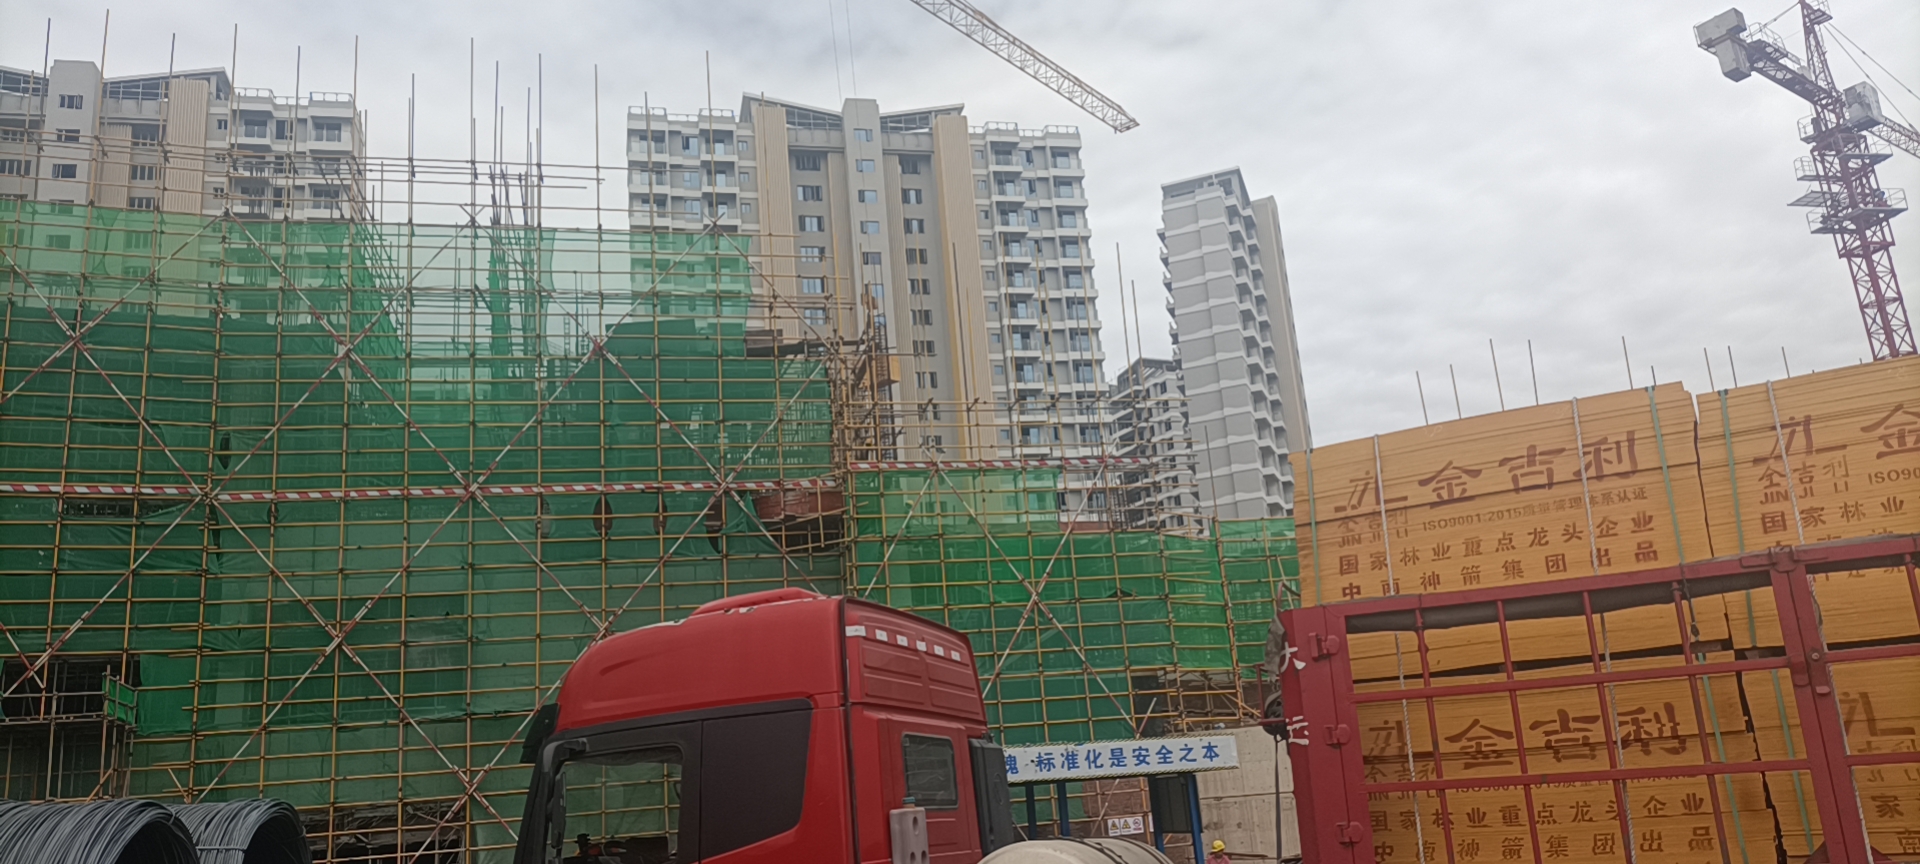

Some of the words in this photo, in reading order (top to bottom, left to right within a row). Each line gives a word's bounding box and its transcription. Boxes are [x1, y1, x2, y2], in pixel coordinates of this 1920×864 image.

[1418, 430, 1639, 509] 金吉利
[1760, 489, 1789, 505] JIN
[1799, 485, 1814, 499] JI
[1834, 480, 1848, 494] LI
[1761, 496, 1907, 534] 国家林业
[1338, 533, 1362, 549] JIN
[1396, 528, 1408, 539] LI
[1339, 510, 1654, 576] 国家林业重点龙头企业
[1444, 702, 1688, 770] 金吉利
[1035, 741, 1220, 773] 标准化是安全之本
[1370, 792, 1705, 833] 国家林业重点龙头企业
[1374, 826, 1715, 863] 中南神箭集团出品
